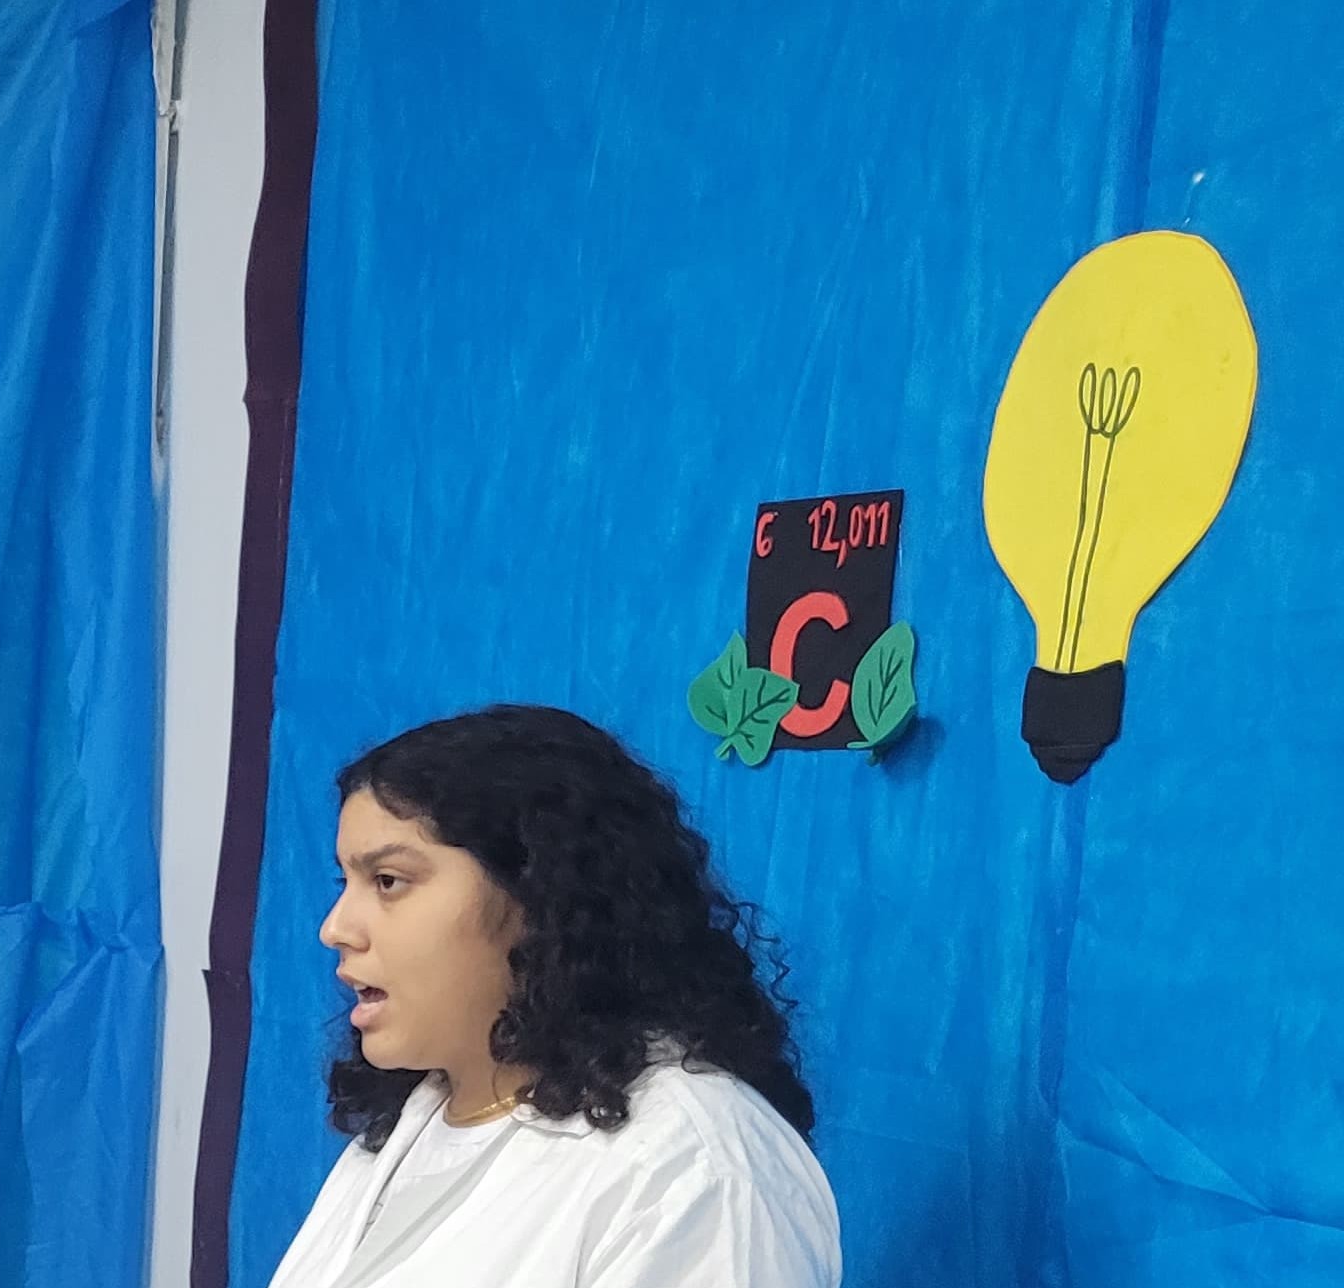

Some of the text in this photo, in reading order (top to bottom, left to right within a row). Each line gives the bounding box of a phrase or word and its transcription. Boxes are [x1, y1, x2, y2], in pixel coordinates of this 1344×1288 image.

[755, 499, 891, 569] 6 12,011
[770, 591, 851, 738] C
